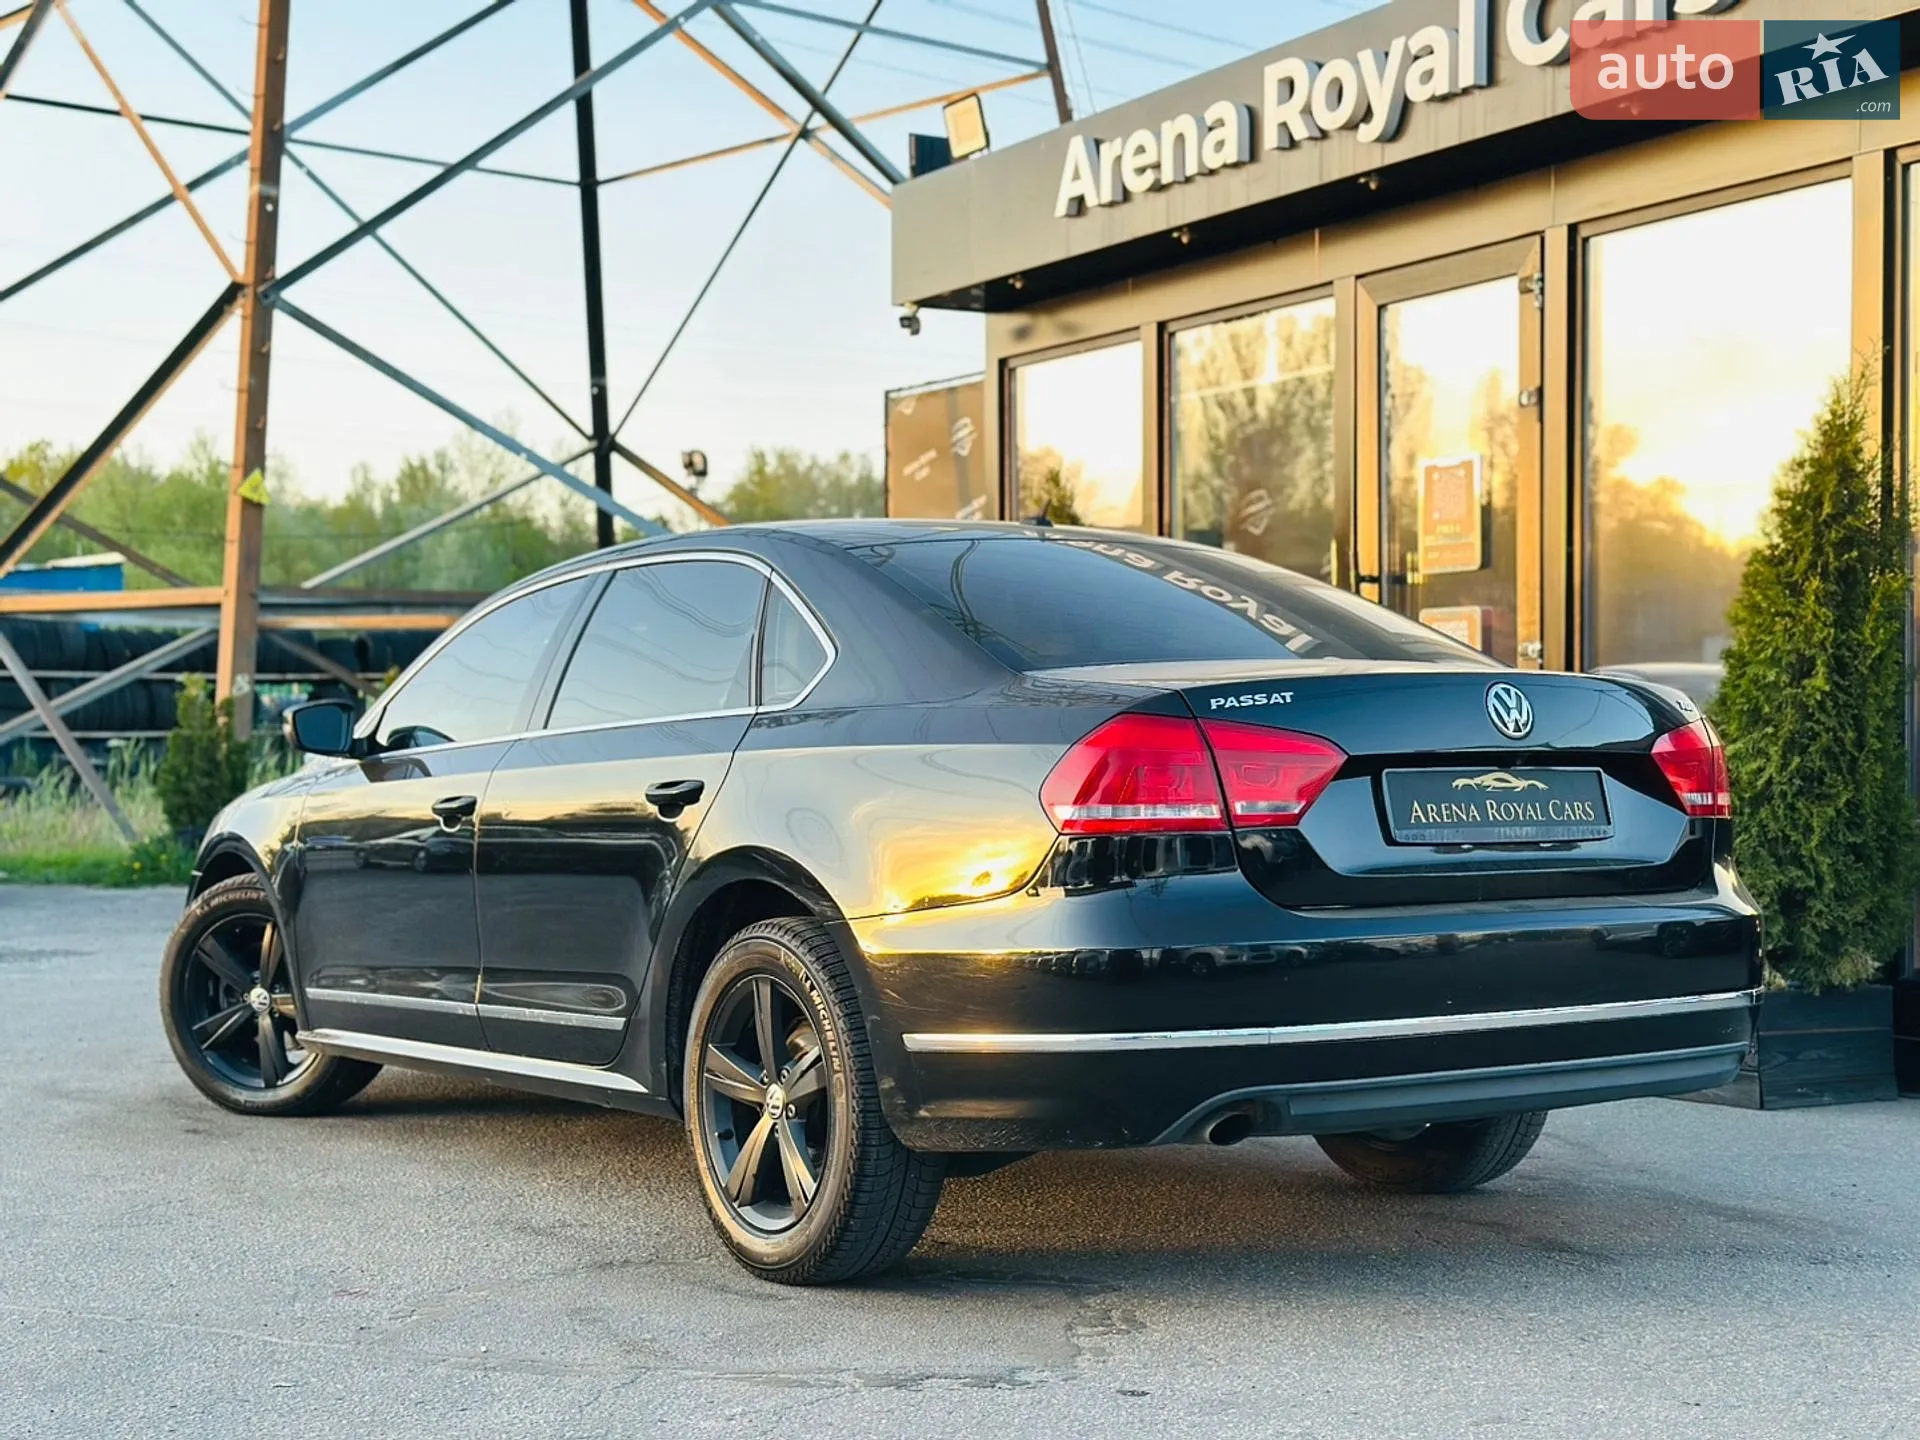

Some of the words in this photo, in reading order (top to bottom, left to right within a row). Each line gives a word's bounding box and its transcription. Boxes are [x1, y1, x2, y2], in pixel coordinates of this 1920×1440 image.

[1054, 100, 1242, 218] Arena
[1263, 0, 1480, 150] Royal
[1210, 691, 1295, 710] PASSAT
[1410, 799, 1482, 824] ARENA
[1486, 798, 1546, 822] ROYAL
[1549, 799, 1596, 822] CARS
[810, 989, 844, 1073] MICHELIN
